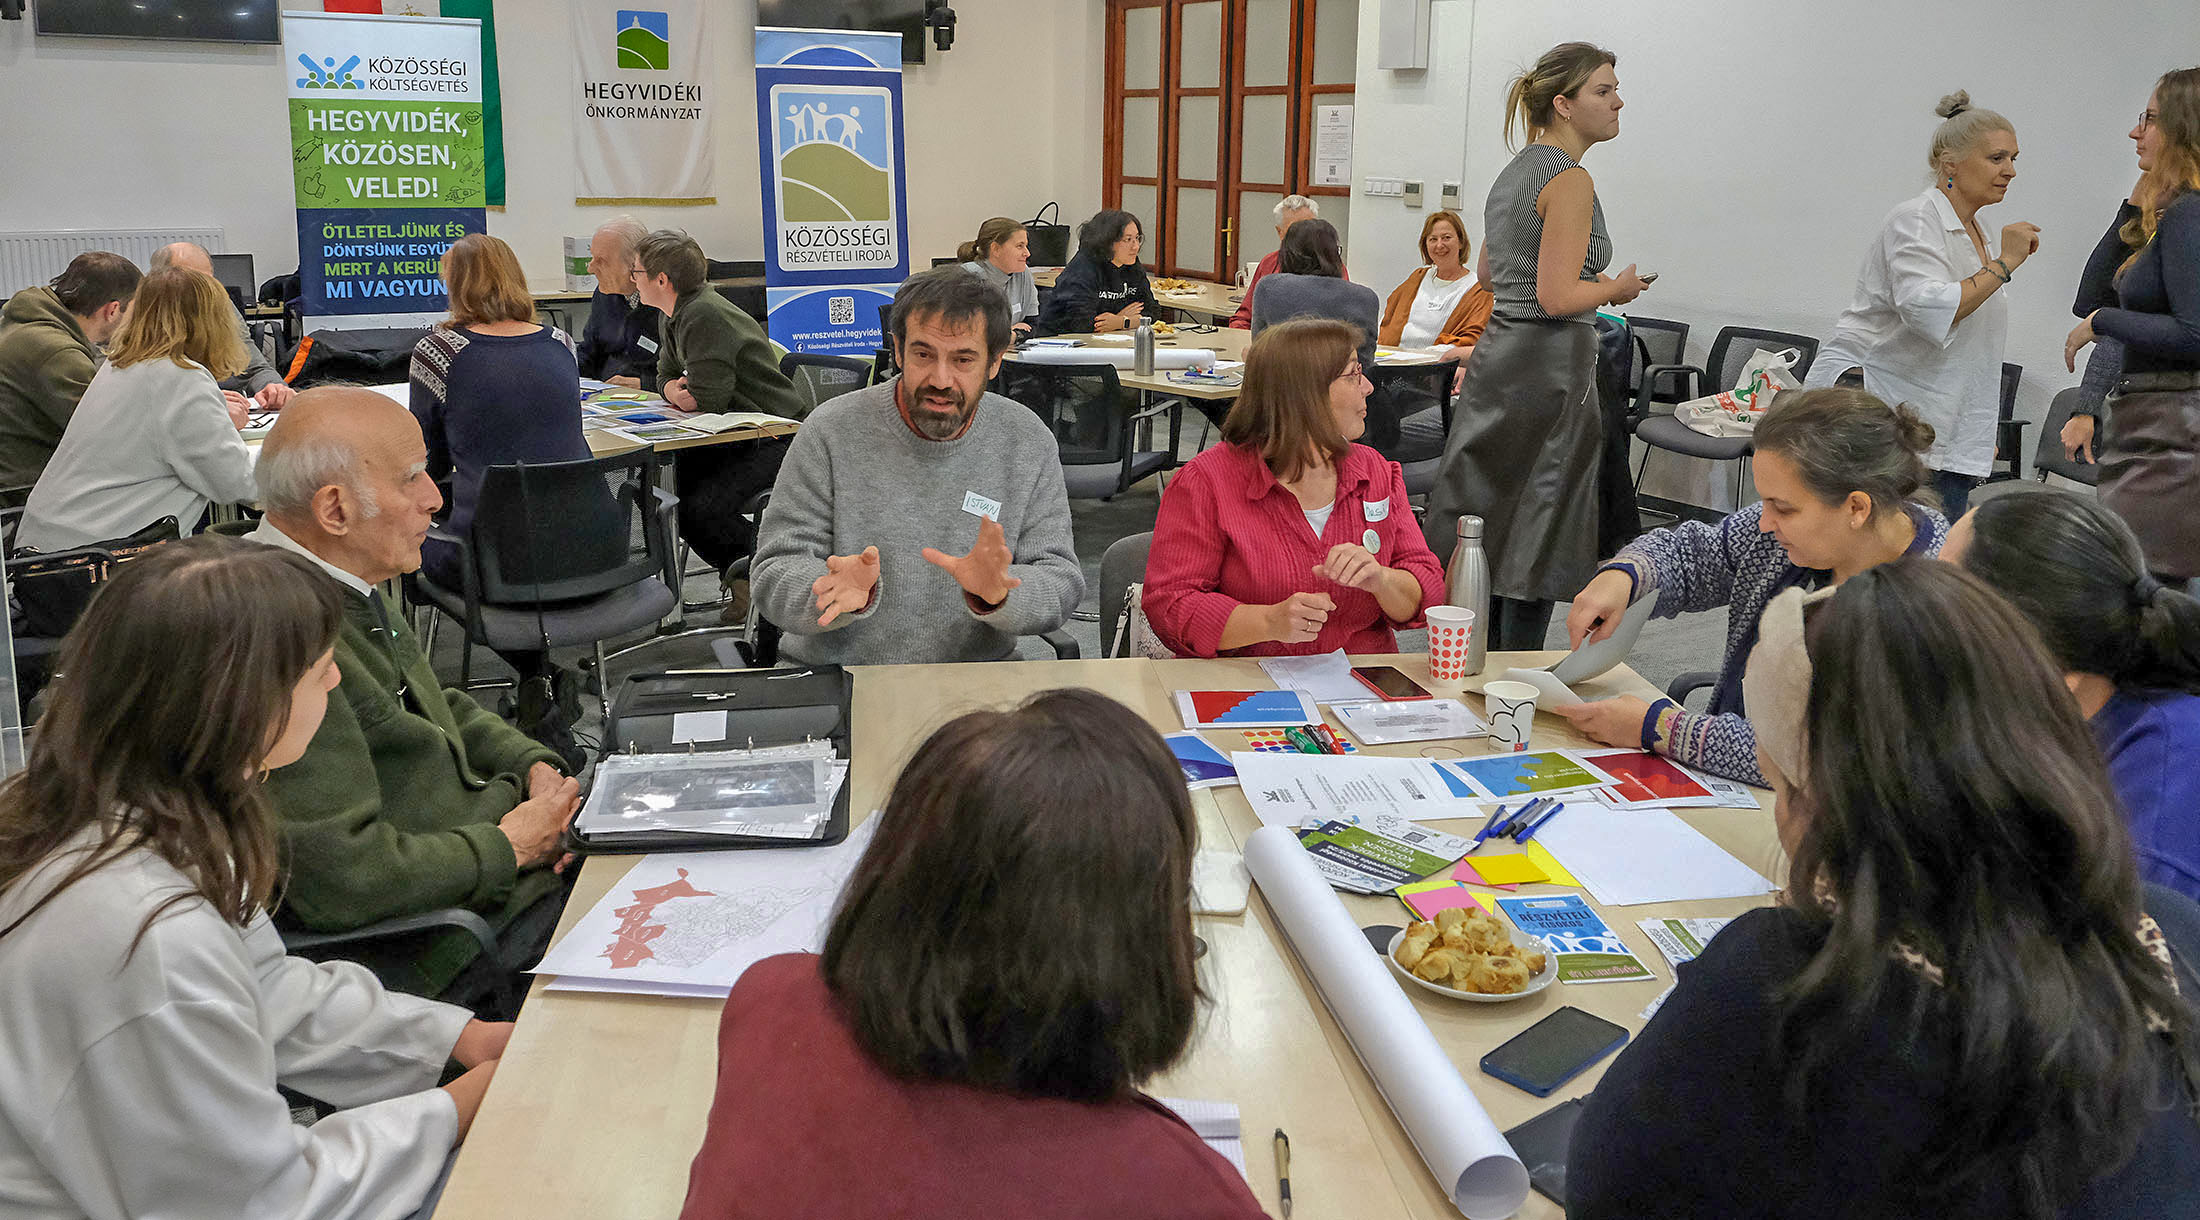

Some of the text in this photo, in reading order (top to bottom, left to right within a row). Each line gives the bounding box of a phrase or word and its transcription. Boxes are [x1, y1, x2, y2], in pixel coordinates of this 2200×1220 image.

[368, 56, 467, 76] KÖZÖSSÉGI
[369, 76, 469, 93] KÖLTSÉGVETÉS
[584, 81, 701, 101] HEGYVIDÉKI
[585, 103, 701, 120] ÖNKORMÁNYZAT
[307, 106, 468, 138] HEGYVIDÉK,
[323, 138, 457, 170] KÖZÖSEN,
[345, 177, 438, 198] VELED!
[322, 221, 465, 239] ÖTLETELJÜNK ÉS
[785, 224, 890, 248] KÖZÖSSÉGI
[323, 241, 454, 258] DÖNTSÜNK EGYÜT
[786, 249, 892, 263] RÉSZVÉTELI IRODA
[324, 262, 373, 277] MERT
[376, 262, 390, 275] A
[325, 279, 449, 299] MI VAGYUN
[792, 328, 882, 341] www.reszvetel.hegyvidek
